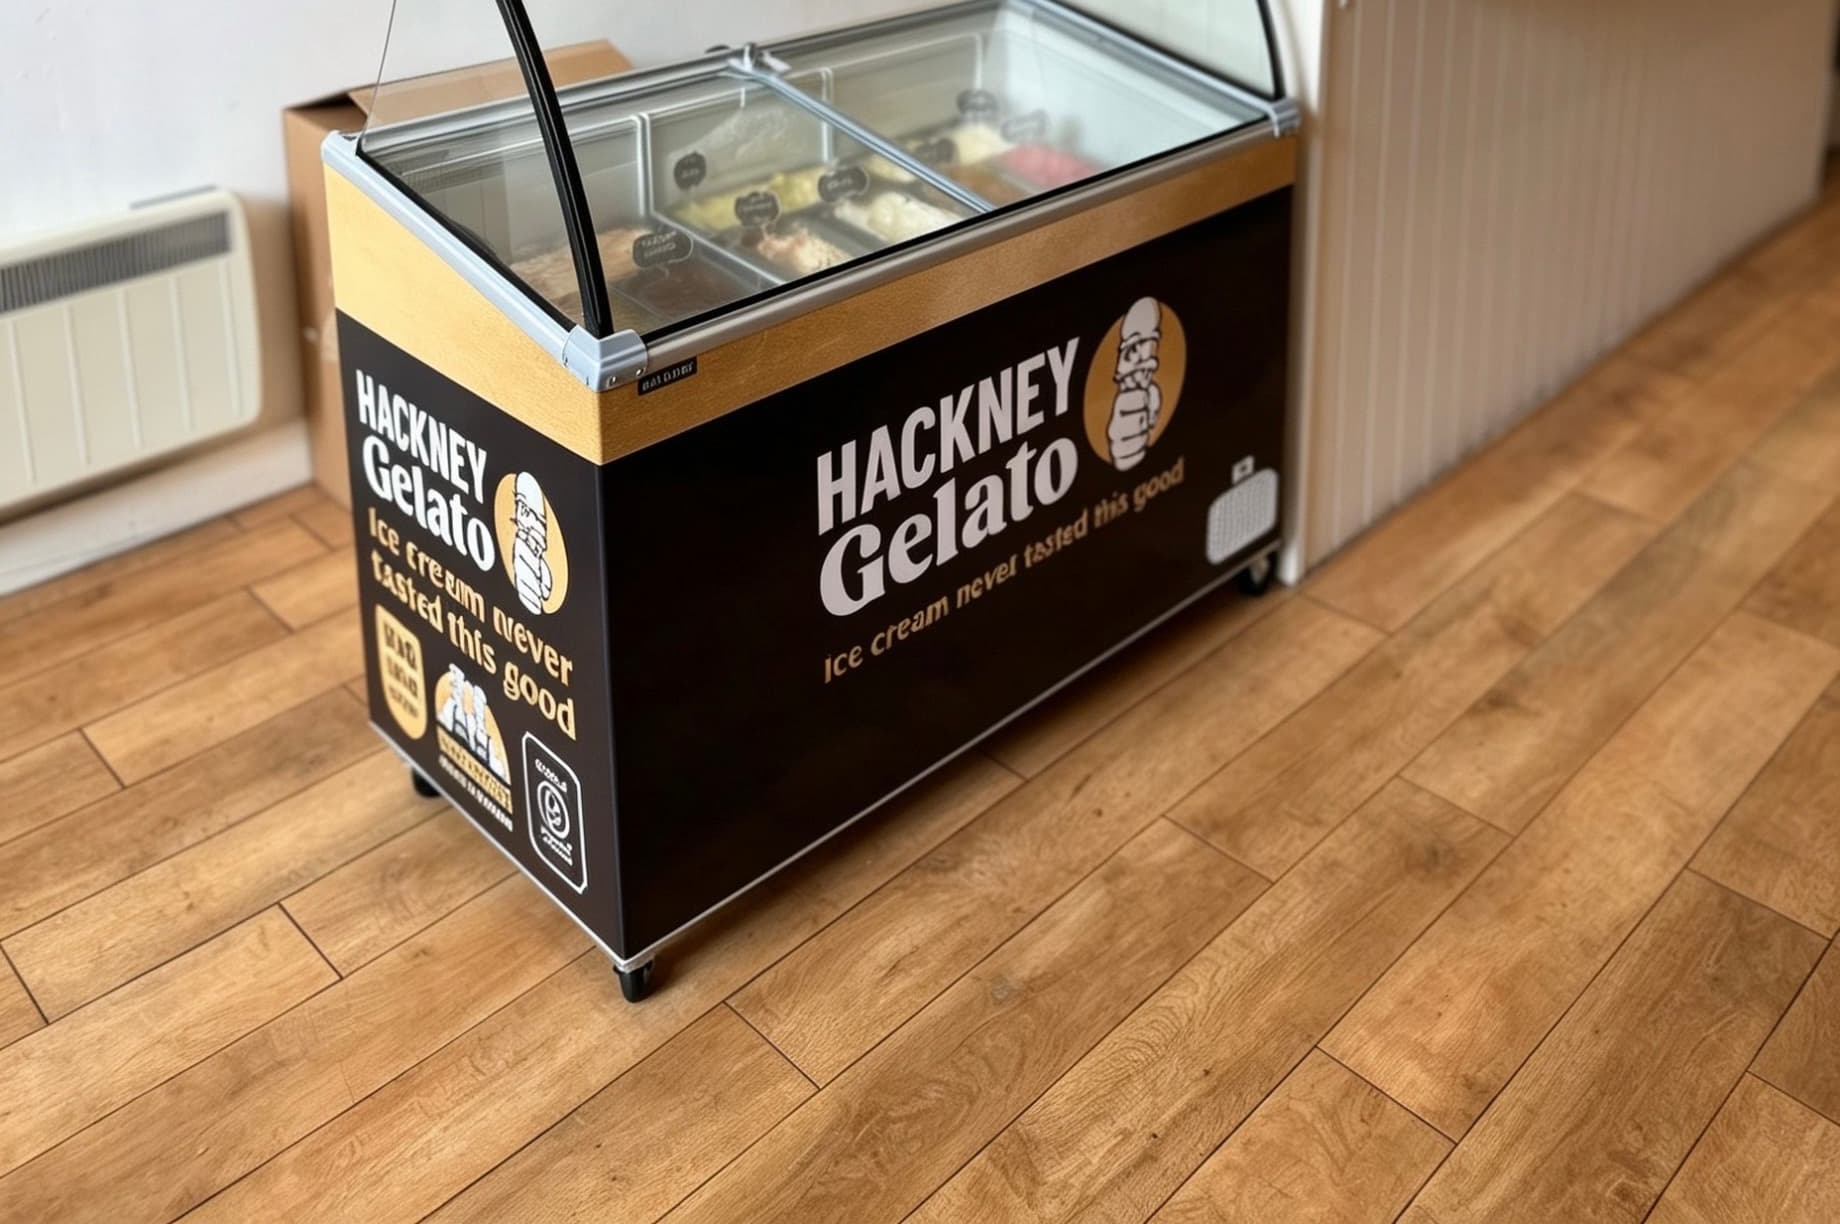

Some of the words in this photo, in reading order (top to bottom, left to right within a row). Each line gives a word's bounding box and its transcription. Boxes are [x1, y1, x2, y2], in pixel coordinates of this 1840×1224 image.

[356, 369, 487, 504] HACKNEY
[362, 435, 495, 572] Gelato
[817, 336, 1081, 536] HACKNEY
[368, 507, 400, 556] Ice
[406, 540, 485, 623] cream
[493, 605, 573, 687] never
[820, 437, 1079, 616] Gelato
[870, 595, 950, 656] cream
[956, 553, 1019, 609] never
[1024, 507, 1088, 569] tasted
[1094, 491, 1129, 528] this
[1133, 455, 1185, 512] good
[371, 549, 444, 633] tasted
[447, 611, 497, 675] this
[504, 661, 577, 741] good
